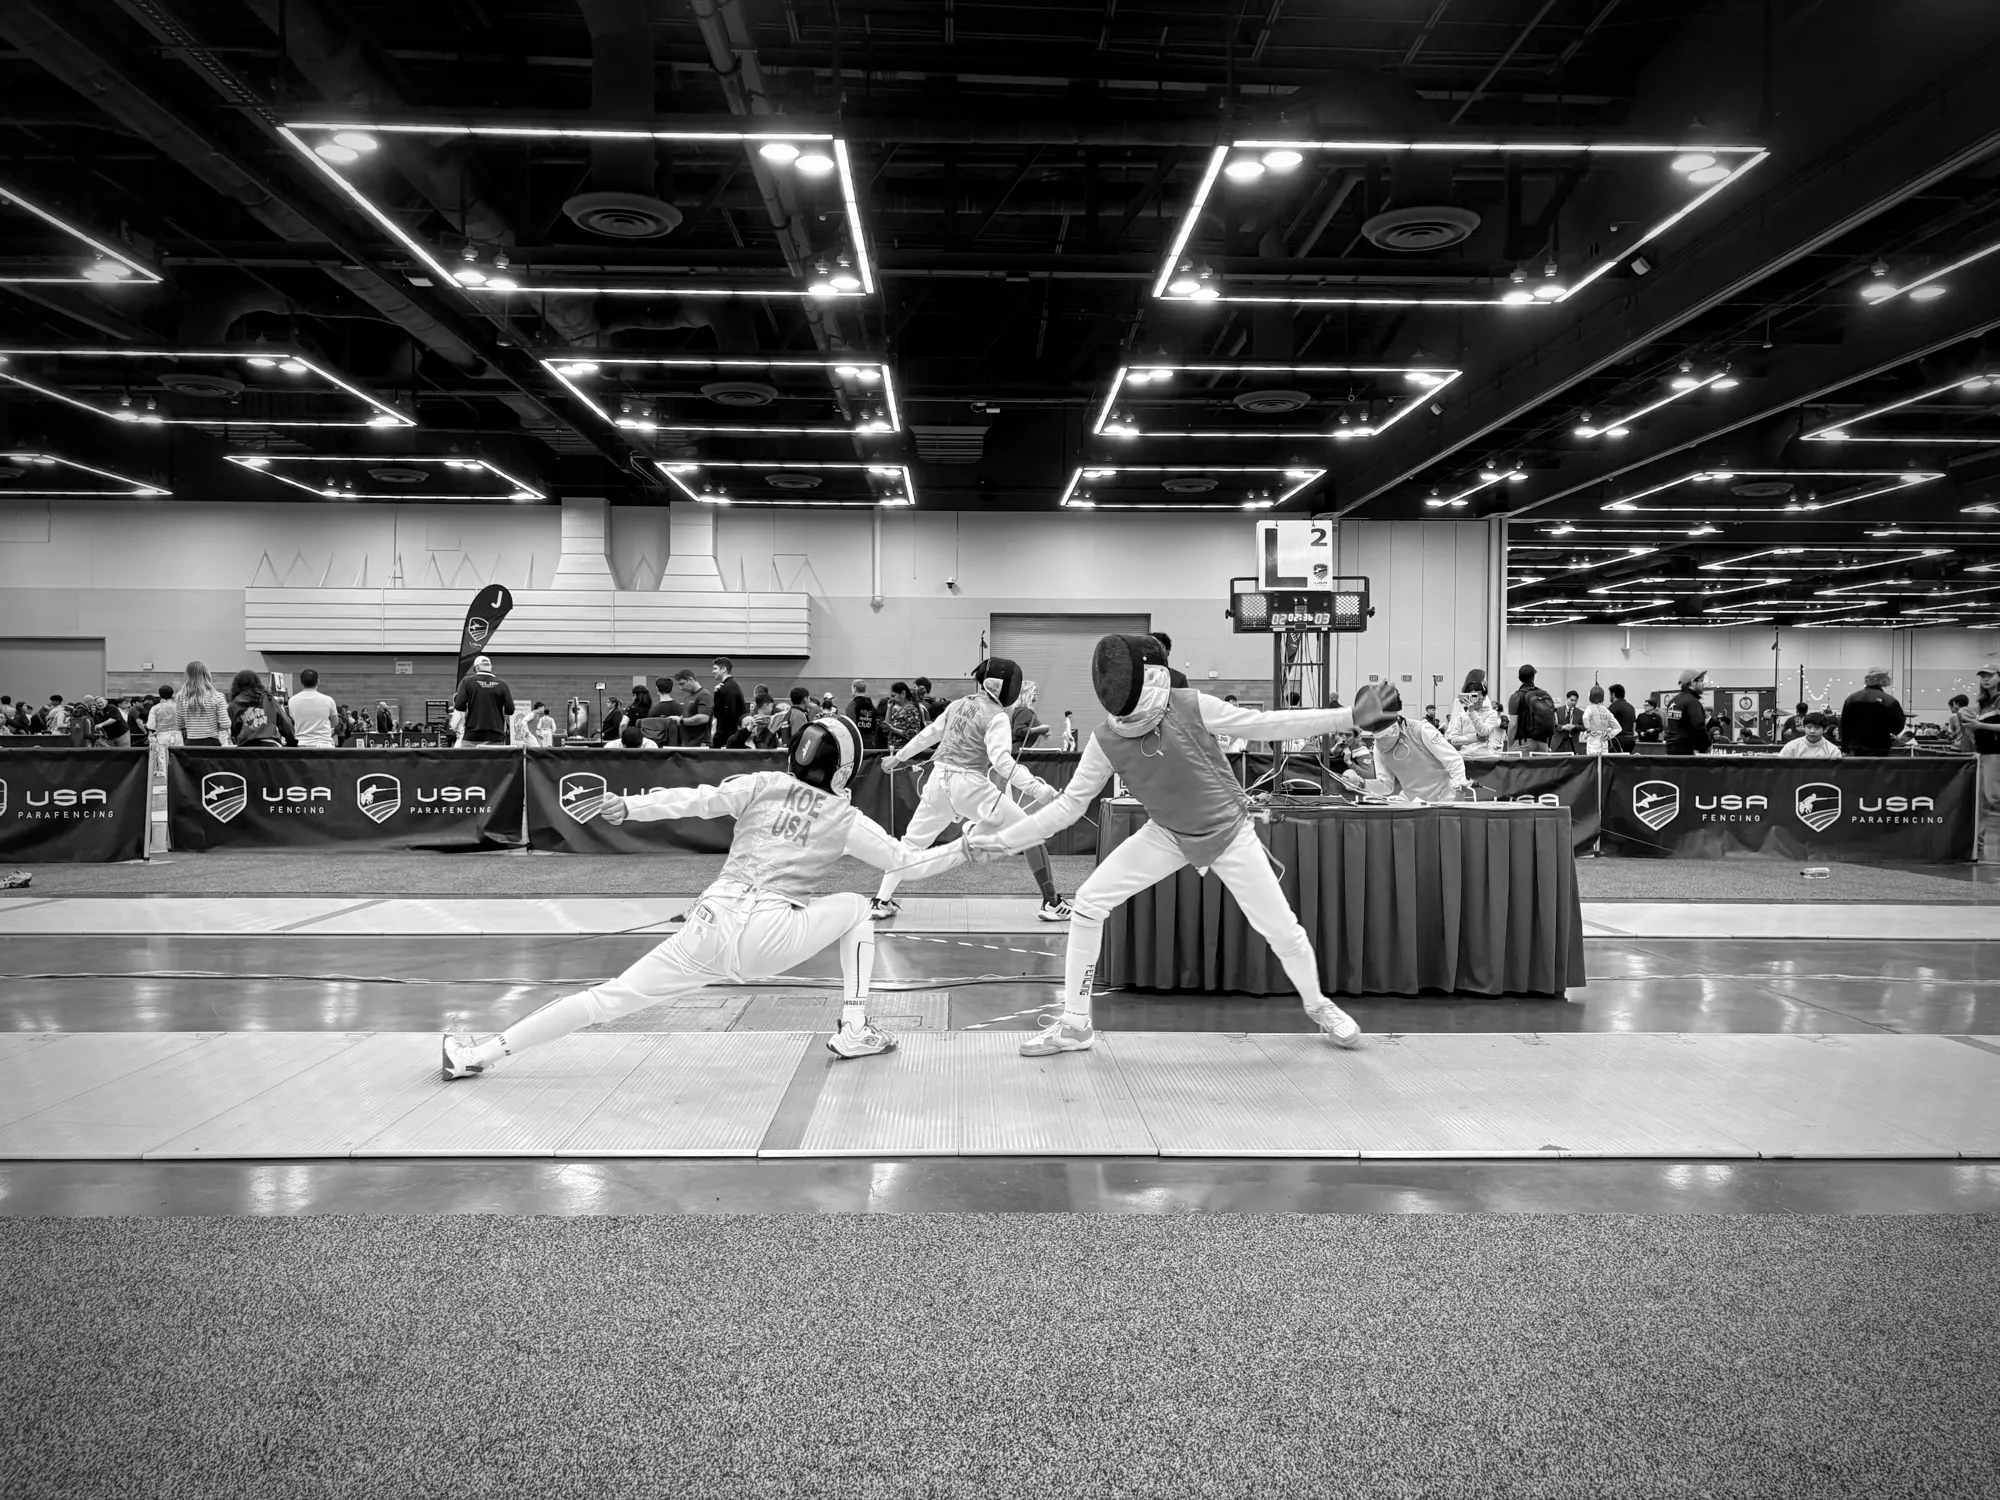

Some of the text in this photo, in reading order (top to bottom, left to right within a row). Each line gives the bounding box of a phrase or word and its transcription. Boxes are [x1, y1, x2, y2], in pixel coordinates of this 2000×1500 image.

[1310, 528, 1328, 547] 2
[1265, 528, 1308, 588] L
[490, 590, 503, 608] J
[1271, 613, 1331, 625] 02 02:36 03
[26, 788, 107, 806] USA
[262, 786, 332, 802] USA
[417, 786, 486, 802] USA
[783, 784, 827, 819] KOE
[1695, 794, 1768, 810] USA
[269, 806, 325, 814] FENCING
[410, 806, 492, 814] PARAFENCING
[1859, 796, 1934, 812] USA
[17, 810, 114, 819] PARAFENCING
[1702, 813, 1761, 822] FENCING
[1851, 816, 1944, 824] PARAFENCING
[771, 811, 812, 847] USA
[1079, 964, 1095, 996] FENCING
